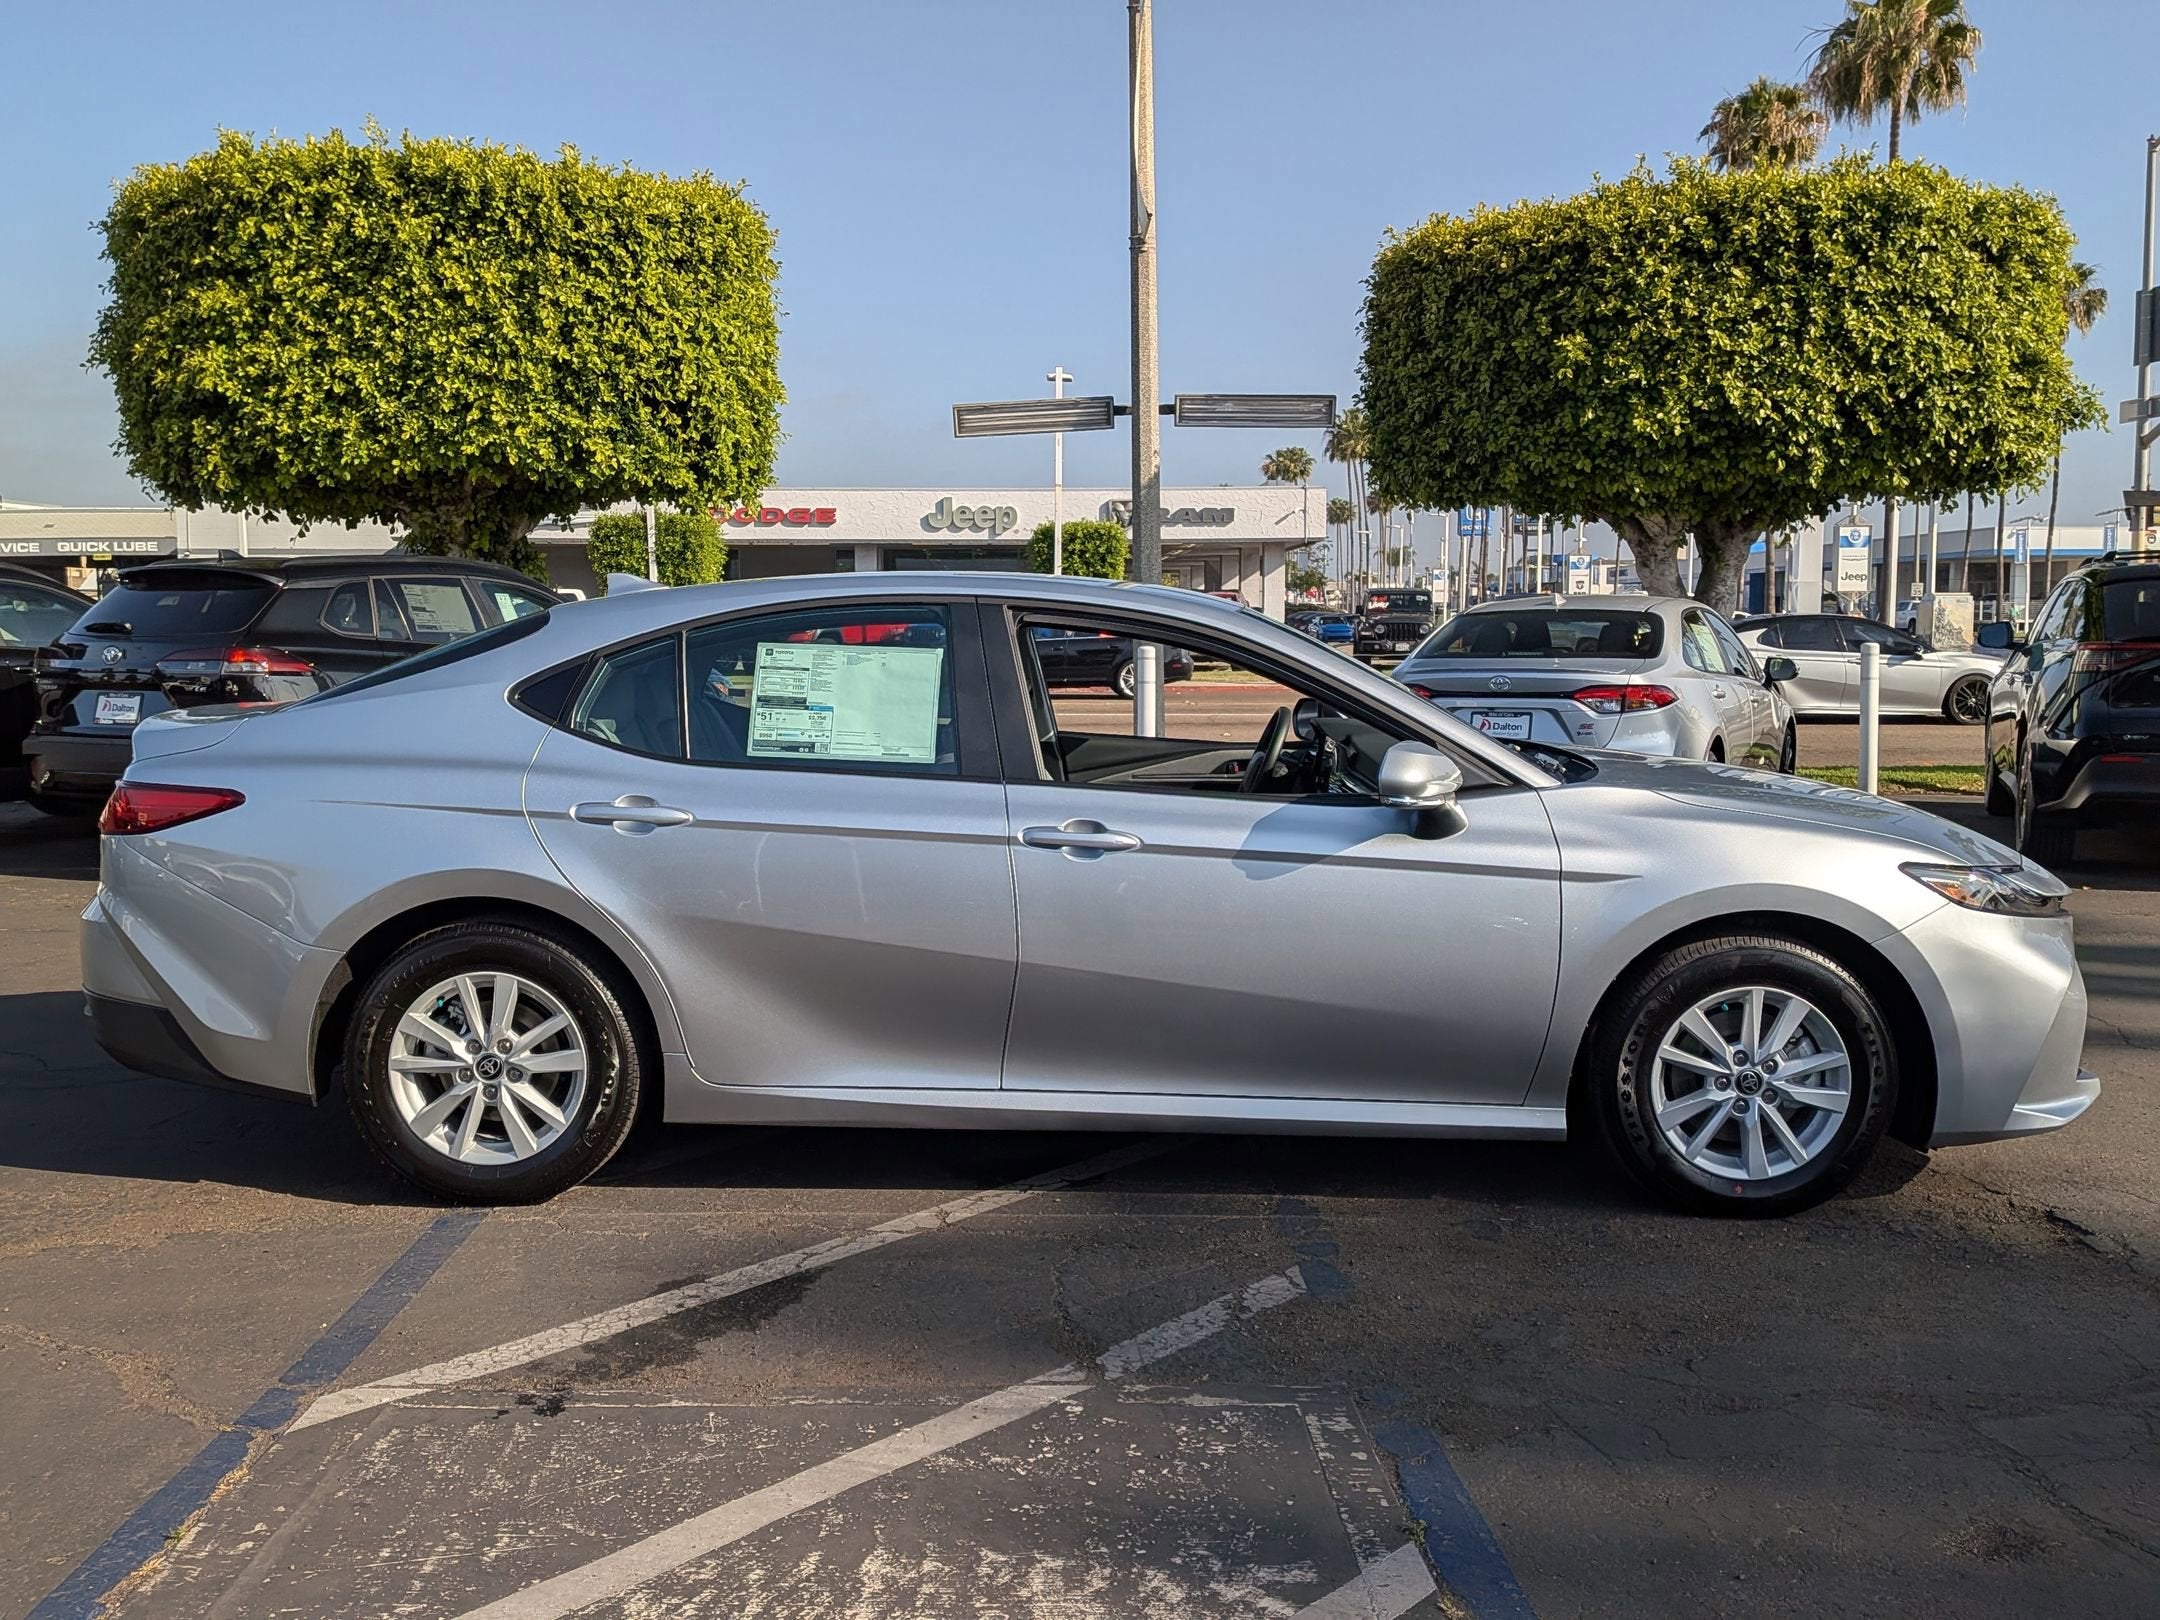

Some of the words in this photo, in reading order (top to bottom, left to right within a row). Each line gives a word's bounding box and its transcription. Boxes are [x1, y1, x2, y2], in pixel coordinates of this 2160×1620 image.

[925, 496, 1018, 535] Jeep
[57, 542, 110, 552] QUICK
[113, 541, 159, 552] LUBE
[1840, 571, 1868, 582] Jeep
[112, 703, 135, 713] Dalton
[760, 711, 773, 721] 51
[1492, 722, 1523, 731] Dalton
